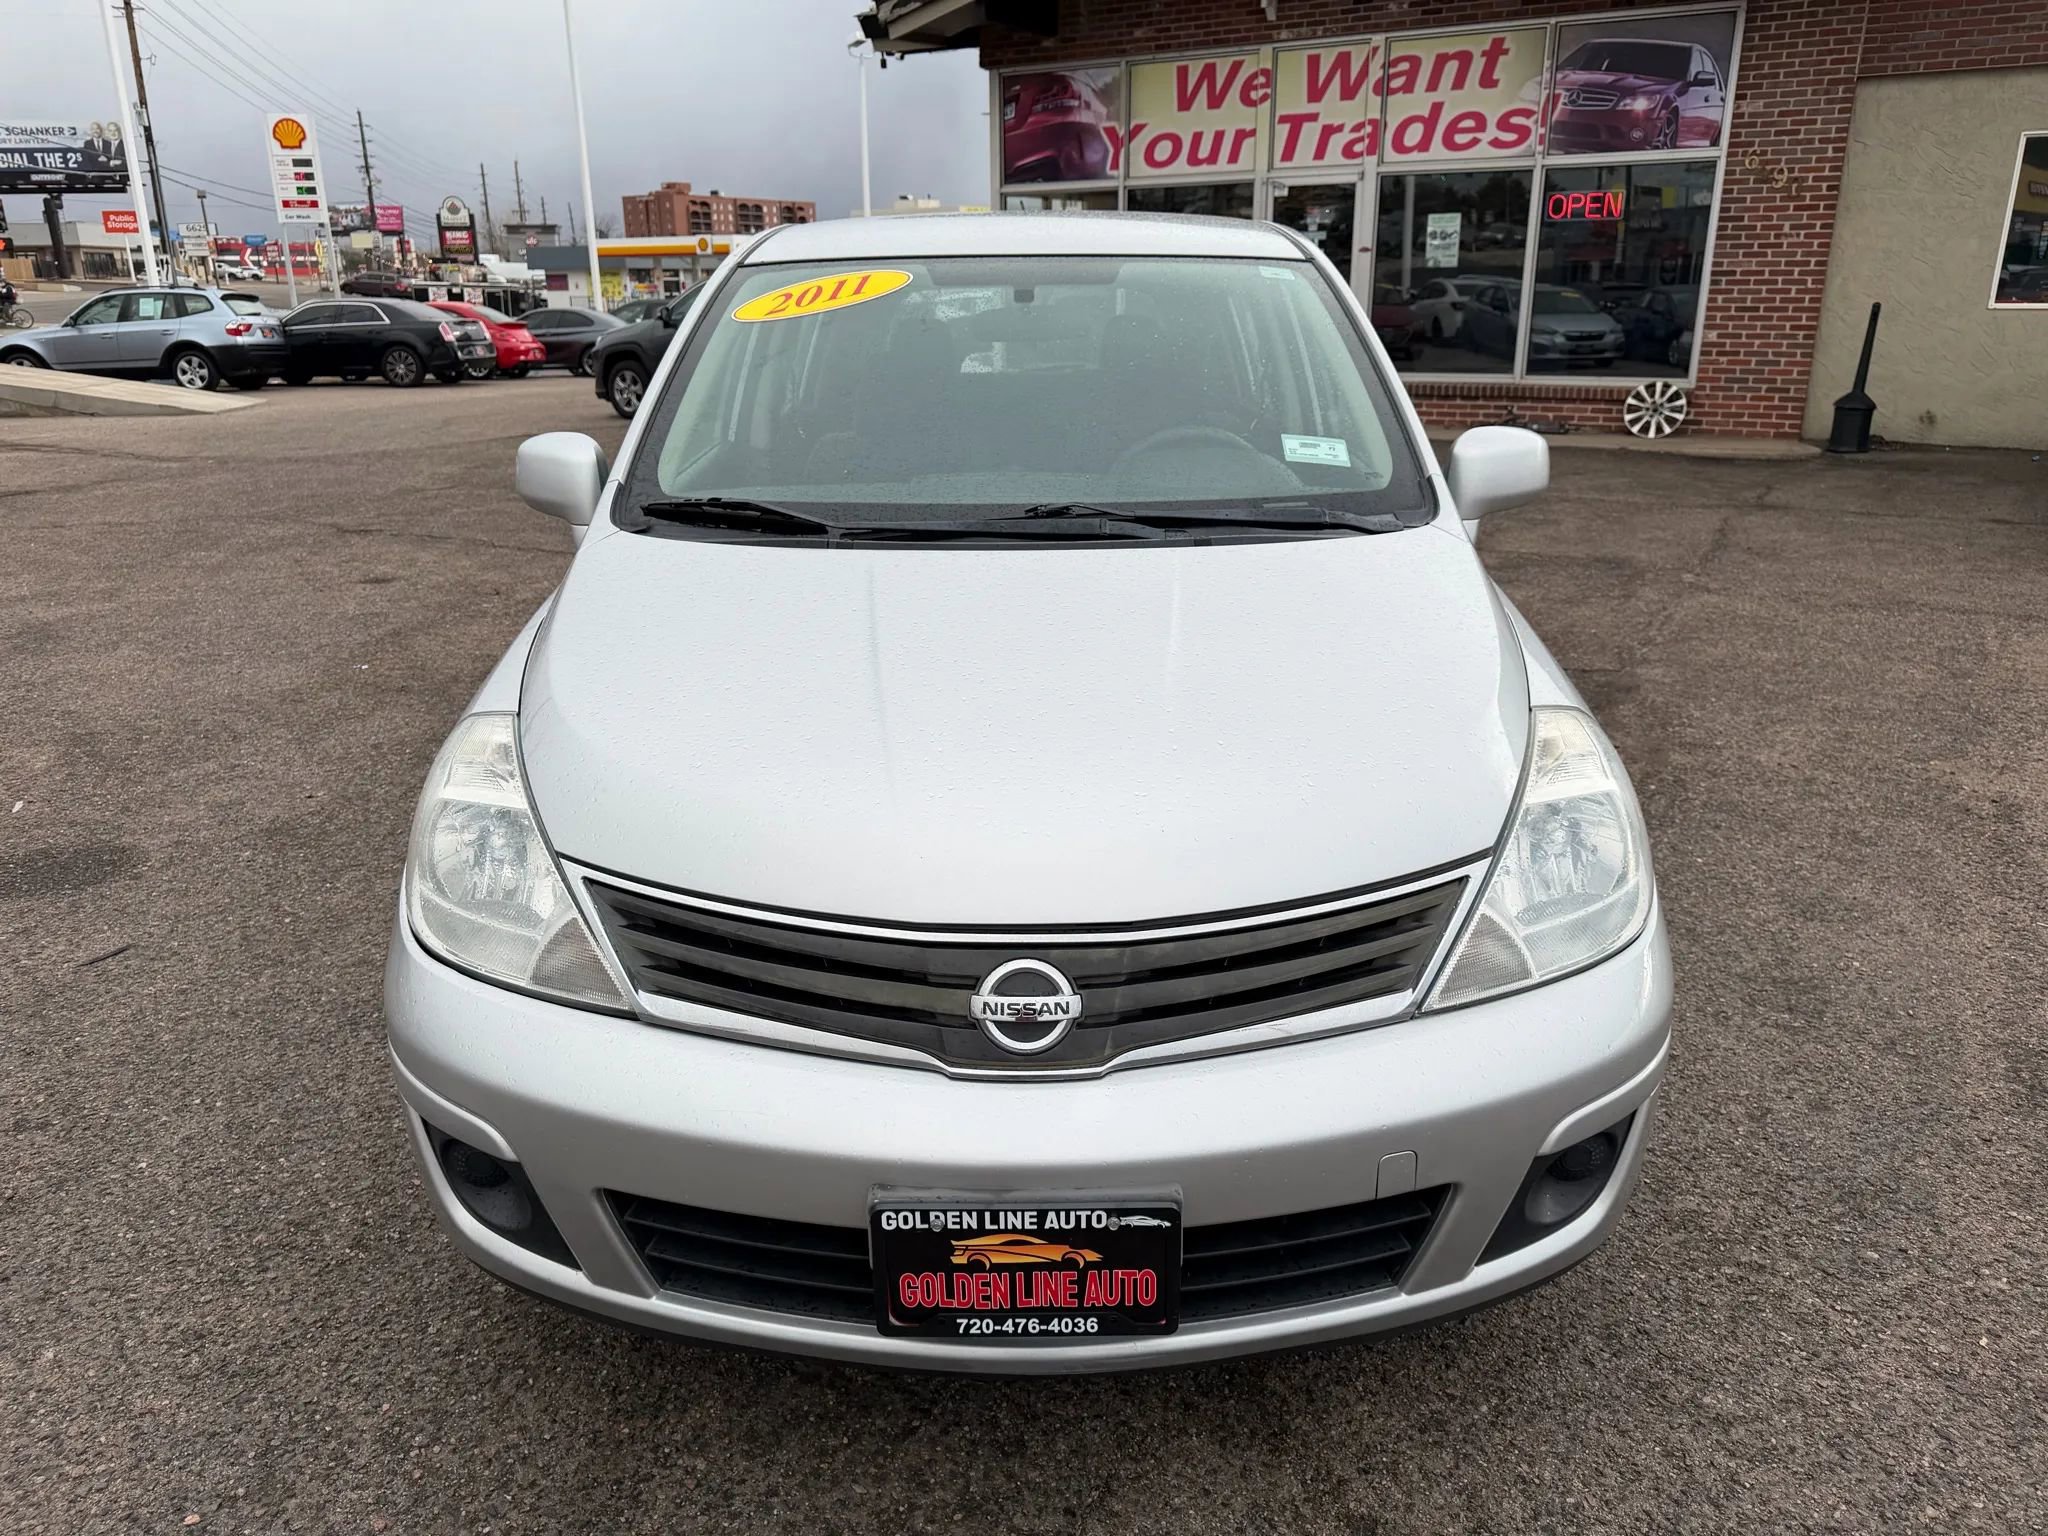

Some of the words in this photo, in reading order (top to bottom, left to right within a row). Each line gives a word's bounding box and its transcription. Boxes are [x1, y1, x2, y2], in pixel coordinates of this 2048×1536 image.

[1175, 59, 1272, 112] We
[1305, 37, 1509, 103] Want
[1101, 122, 1256, 172] Your
[0, 152, 29, 168] DIAL
[33, 152, 66, 168] THE
[1548, 192, 1624, 219] OPEN
[107, 221, 138, 230] Storage
[109, 214, 135, 222] Public
[765, 274, 872, 317] 2011
[982, 1001, 1070, 1017] NISSAN
[881, 1211, 978, 1231] GOLDEN
[984, 1212, 1038, 1230] LINE
[1044, 1210, 1107, 1230] AUTO
[900, 1272, 1010, 1310] GOLDEN
[1016, 1271, 1078, 1308] LINE
[1083, 1269, 1157, 1307] AUTO
[956, 1318, 1099, 1335] 720-476-4036
